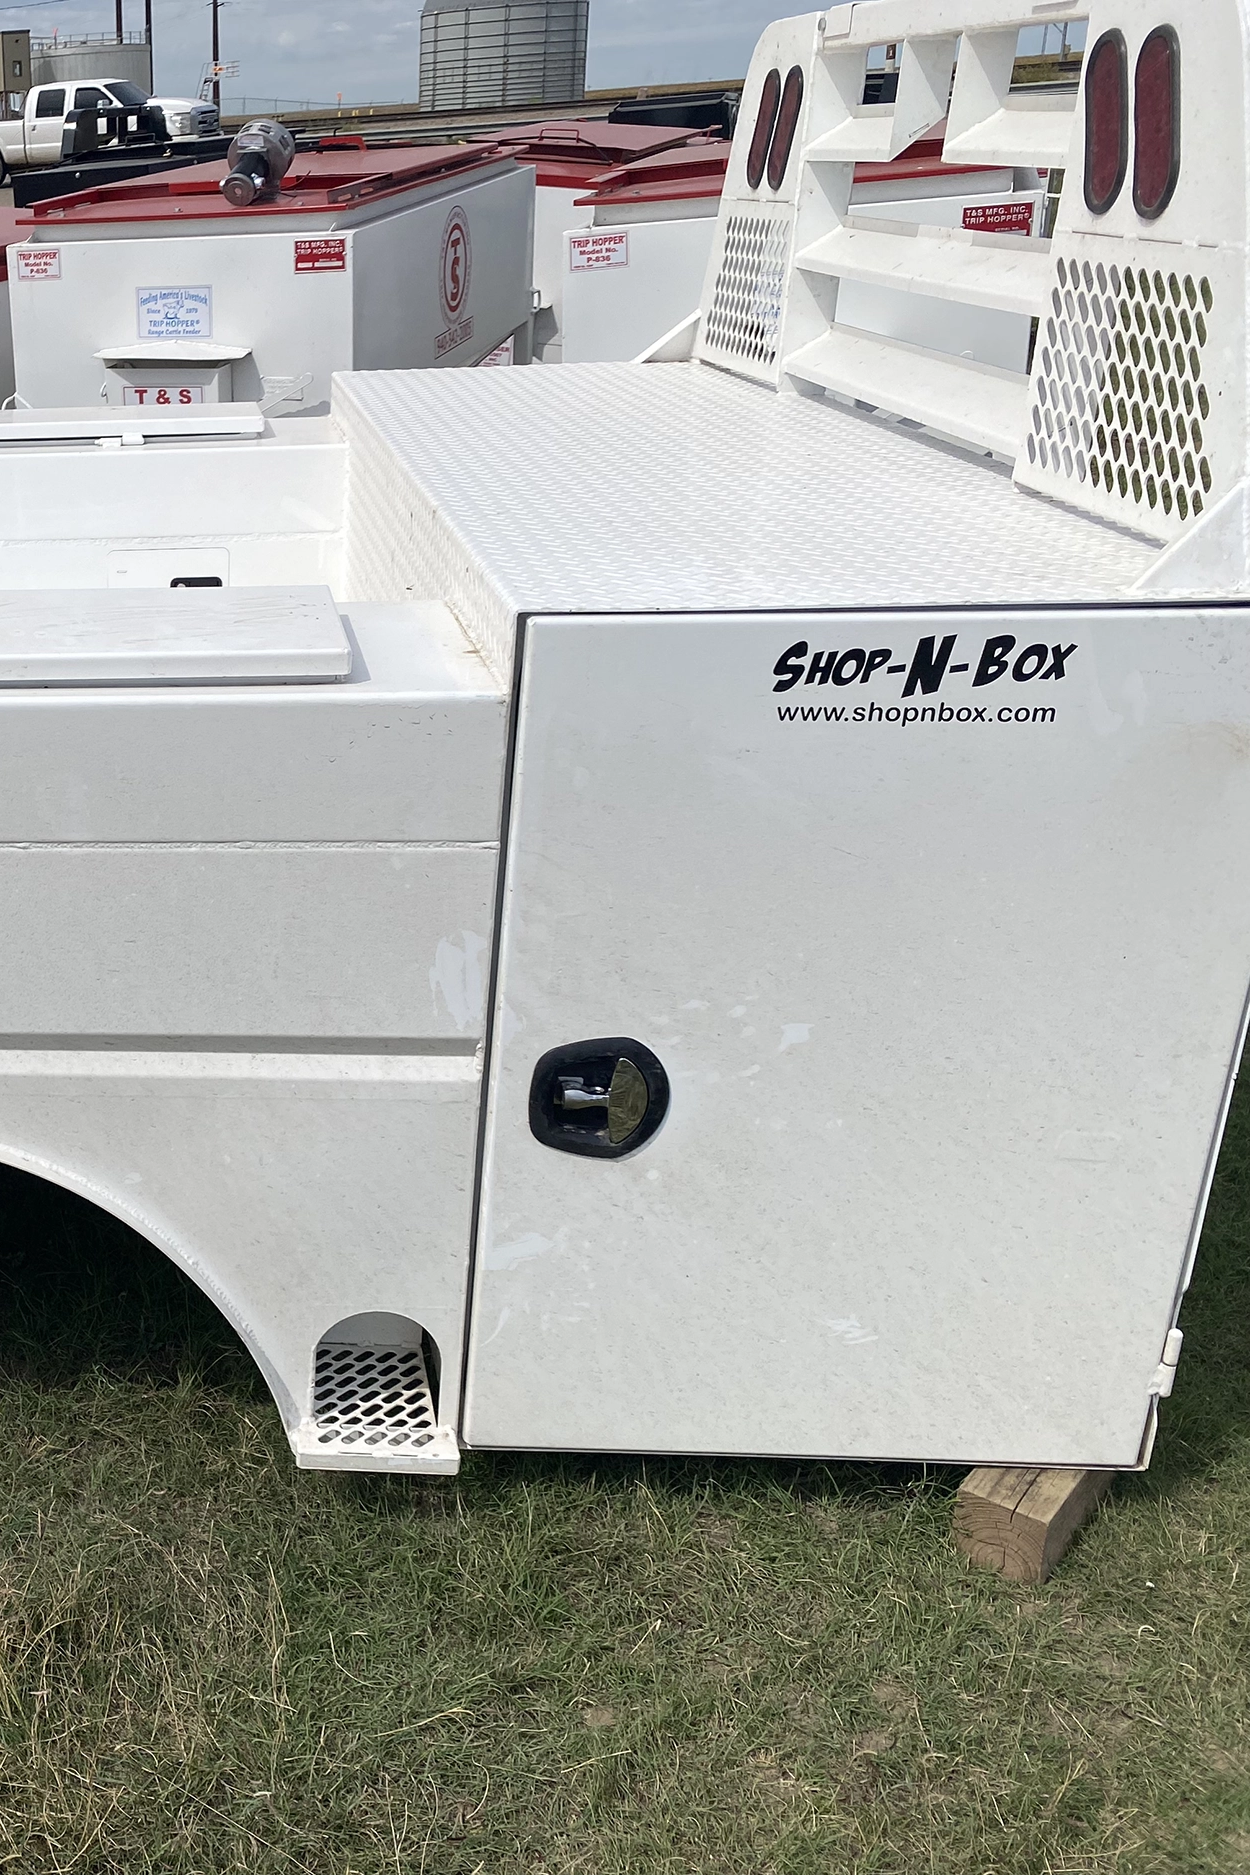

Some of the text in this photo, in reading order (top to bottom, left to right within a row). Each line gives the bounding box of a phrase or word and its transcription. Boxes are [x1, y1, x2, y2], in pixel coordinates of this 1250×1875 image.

[986, 207, 1008, 215] MFG.
[965, 217, 985, 225] TRIP
[572, 239, 590, 249] TRIP
[140, 289, 208, 306] Feeding America's Livestock
[133, 389, 192, 405] T & S
[777, 702, 1056, 727] www.shopnbox.com
